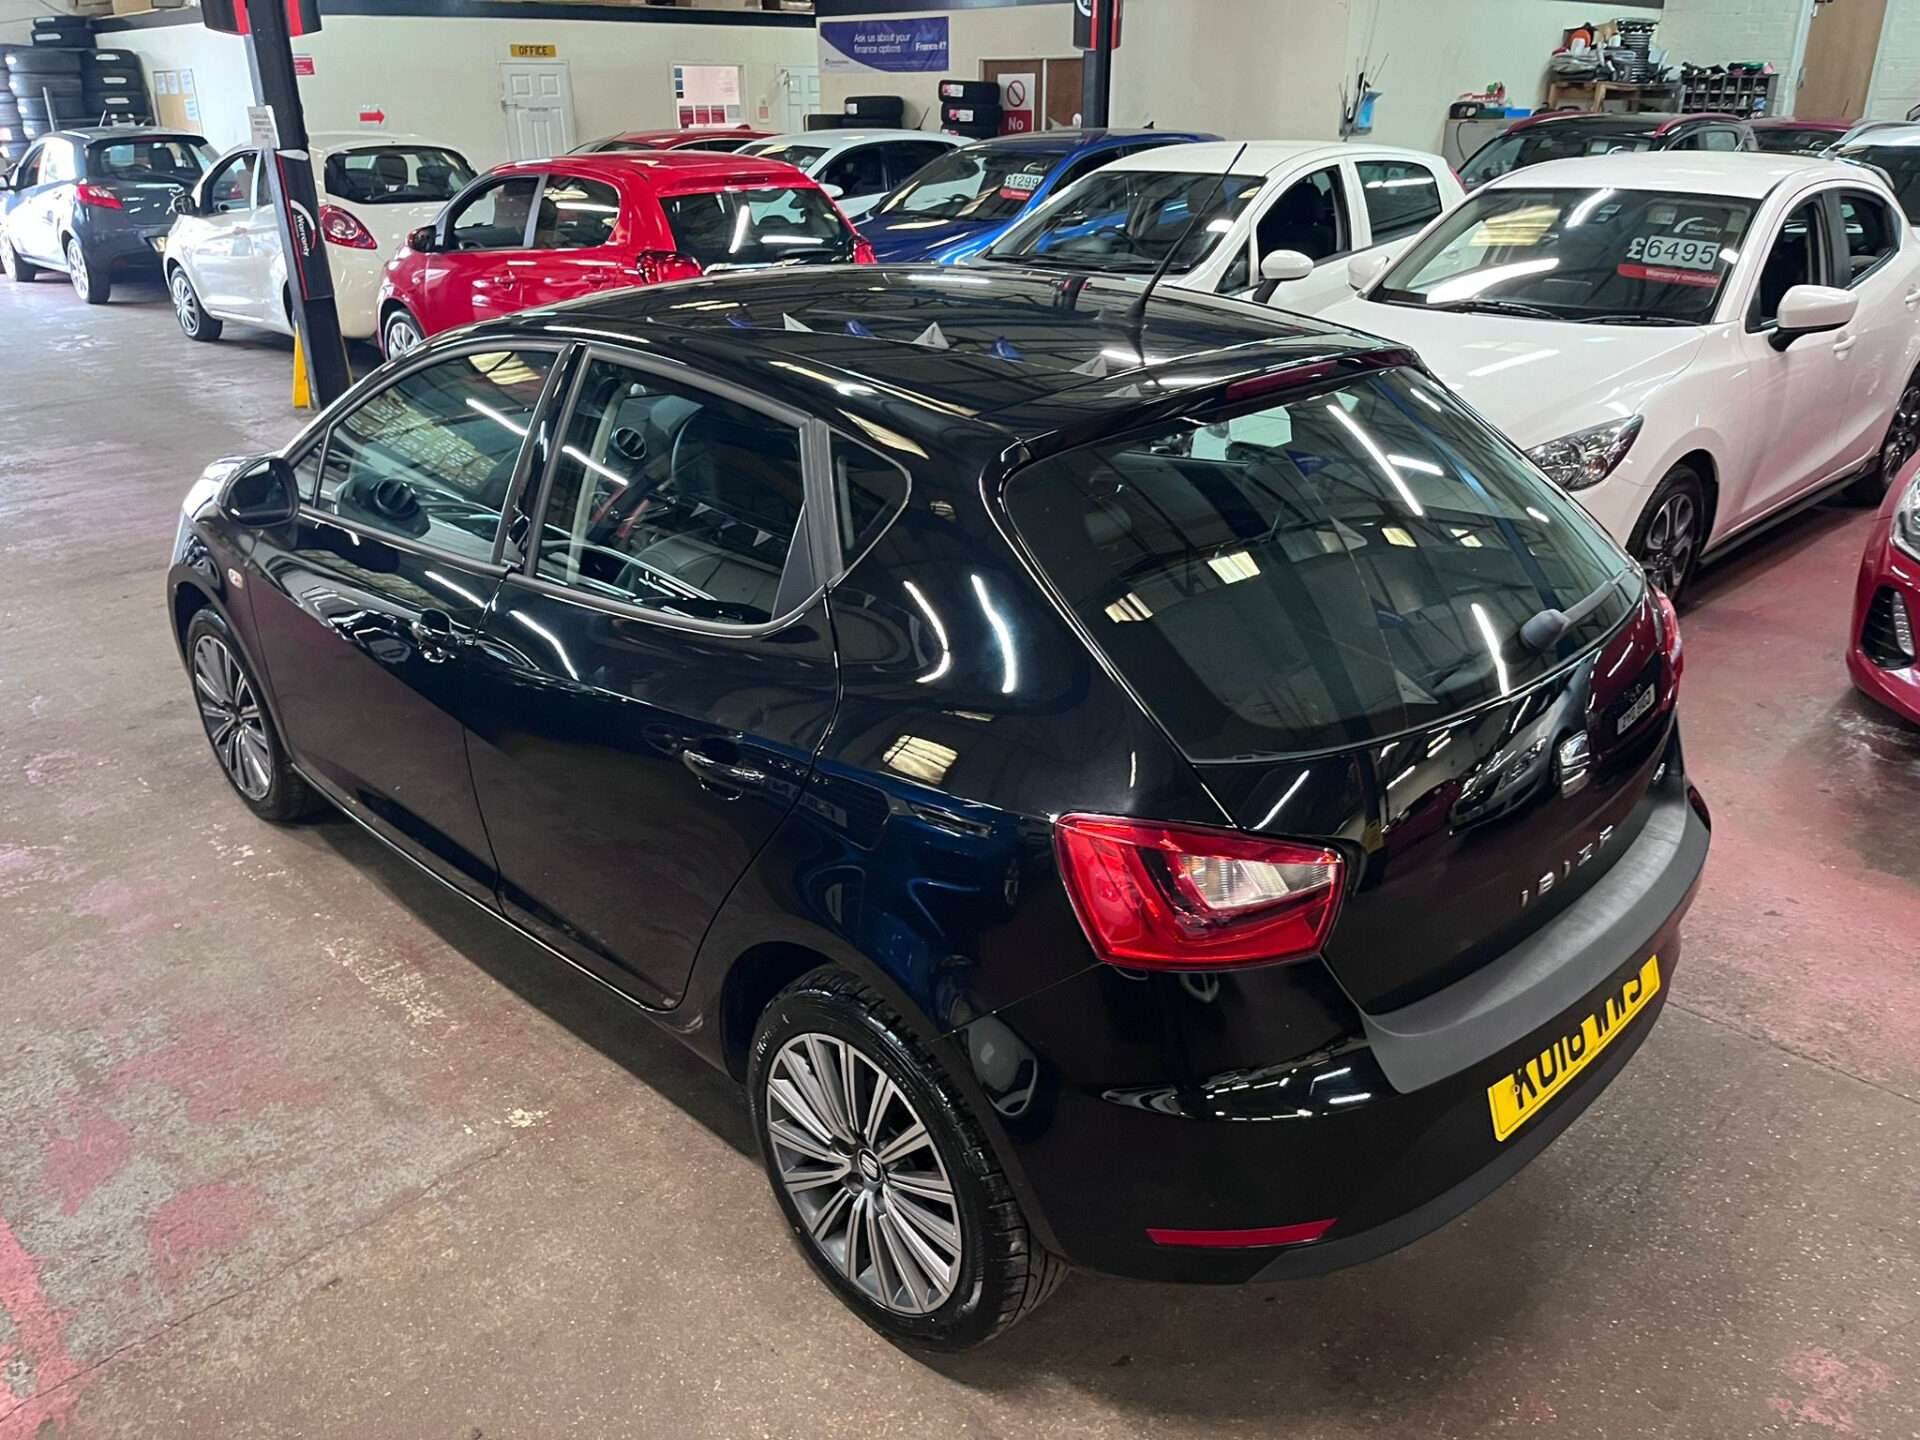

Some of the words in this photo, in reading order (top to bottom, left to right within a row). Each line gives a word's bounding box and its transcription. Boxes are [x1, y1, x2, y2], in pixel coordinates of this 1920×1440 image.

[518, 45, 548, 56] OFFICE
[1008, 116, 1024, 130] No
[1626, 238, 1717, 265] £6495
